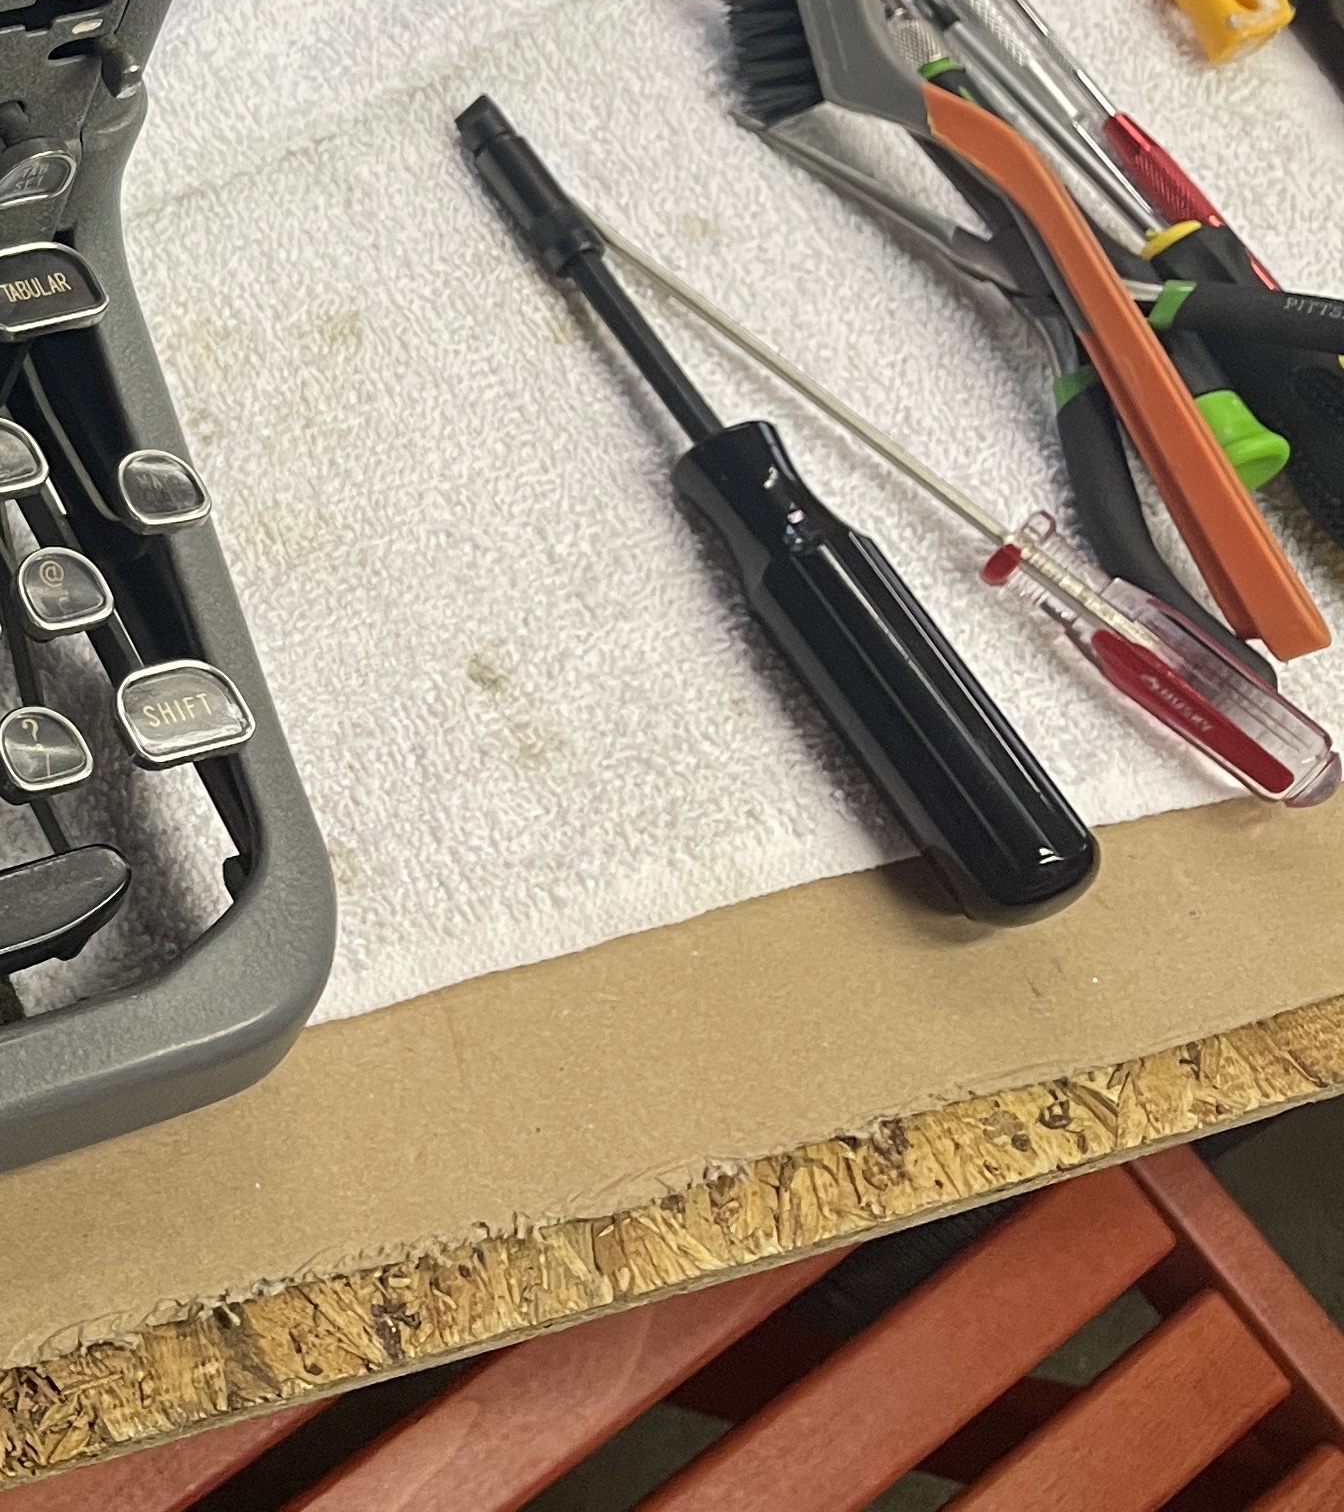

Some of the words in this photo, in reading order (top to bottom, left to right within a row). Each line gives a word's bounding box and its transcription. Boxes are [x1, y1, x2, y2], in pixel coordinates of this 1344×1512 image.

[0, 272, 72, 302] TABULAR
[1283, 297, 1344, 320] PITTS
[38, 559, 65, 588] @
[142, 691, 213, 728] SHIFT
